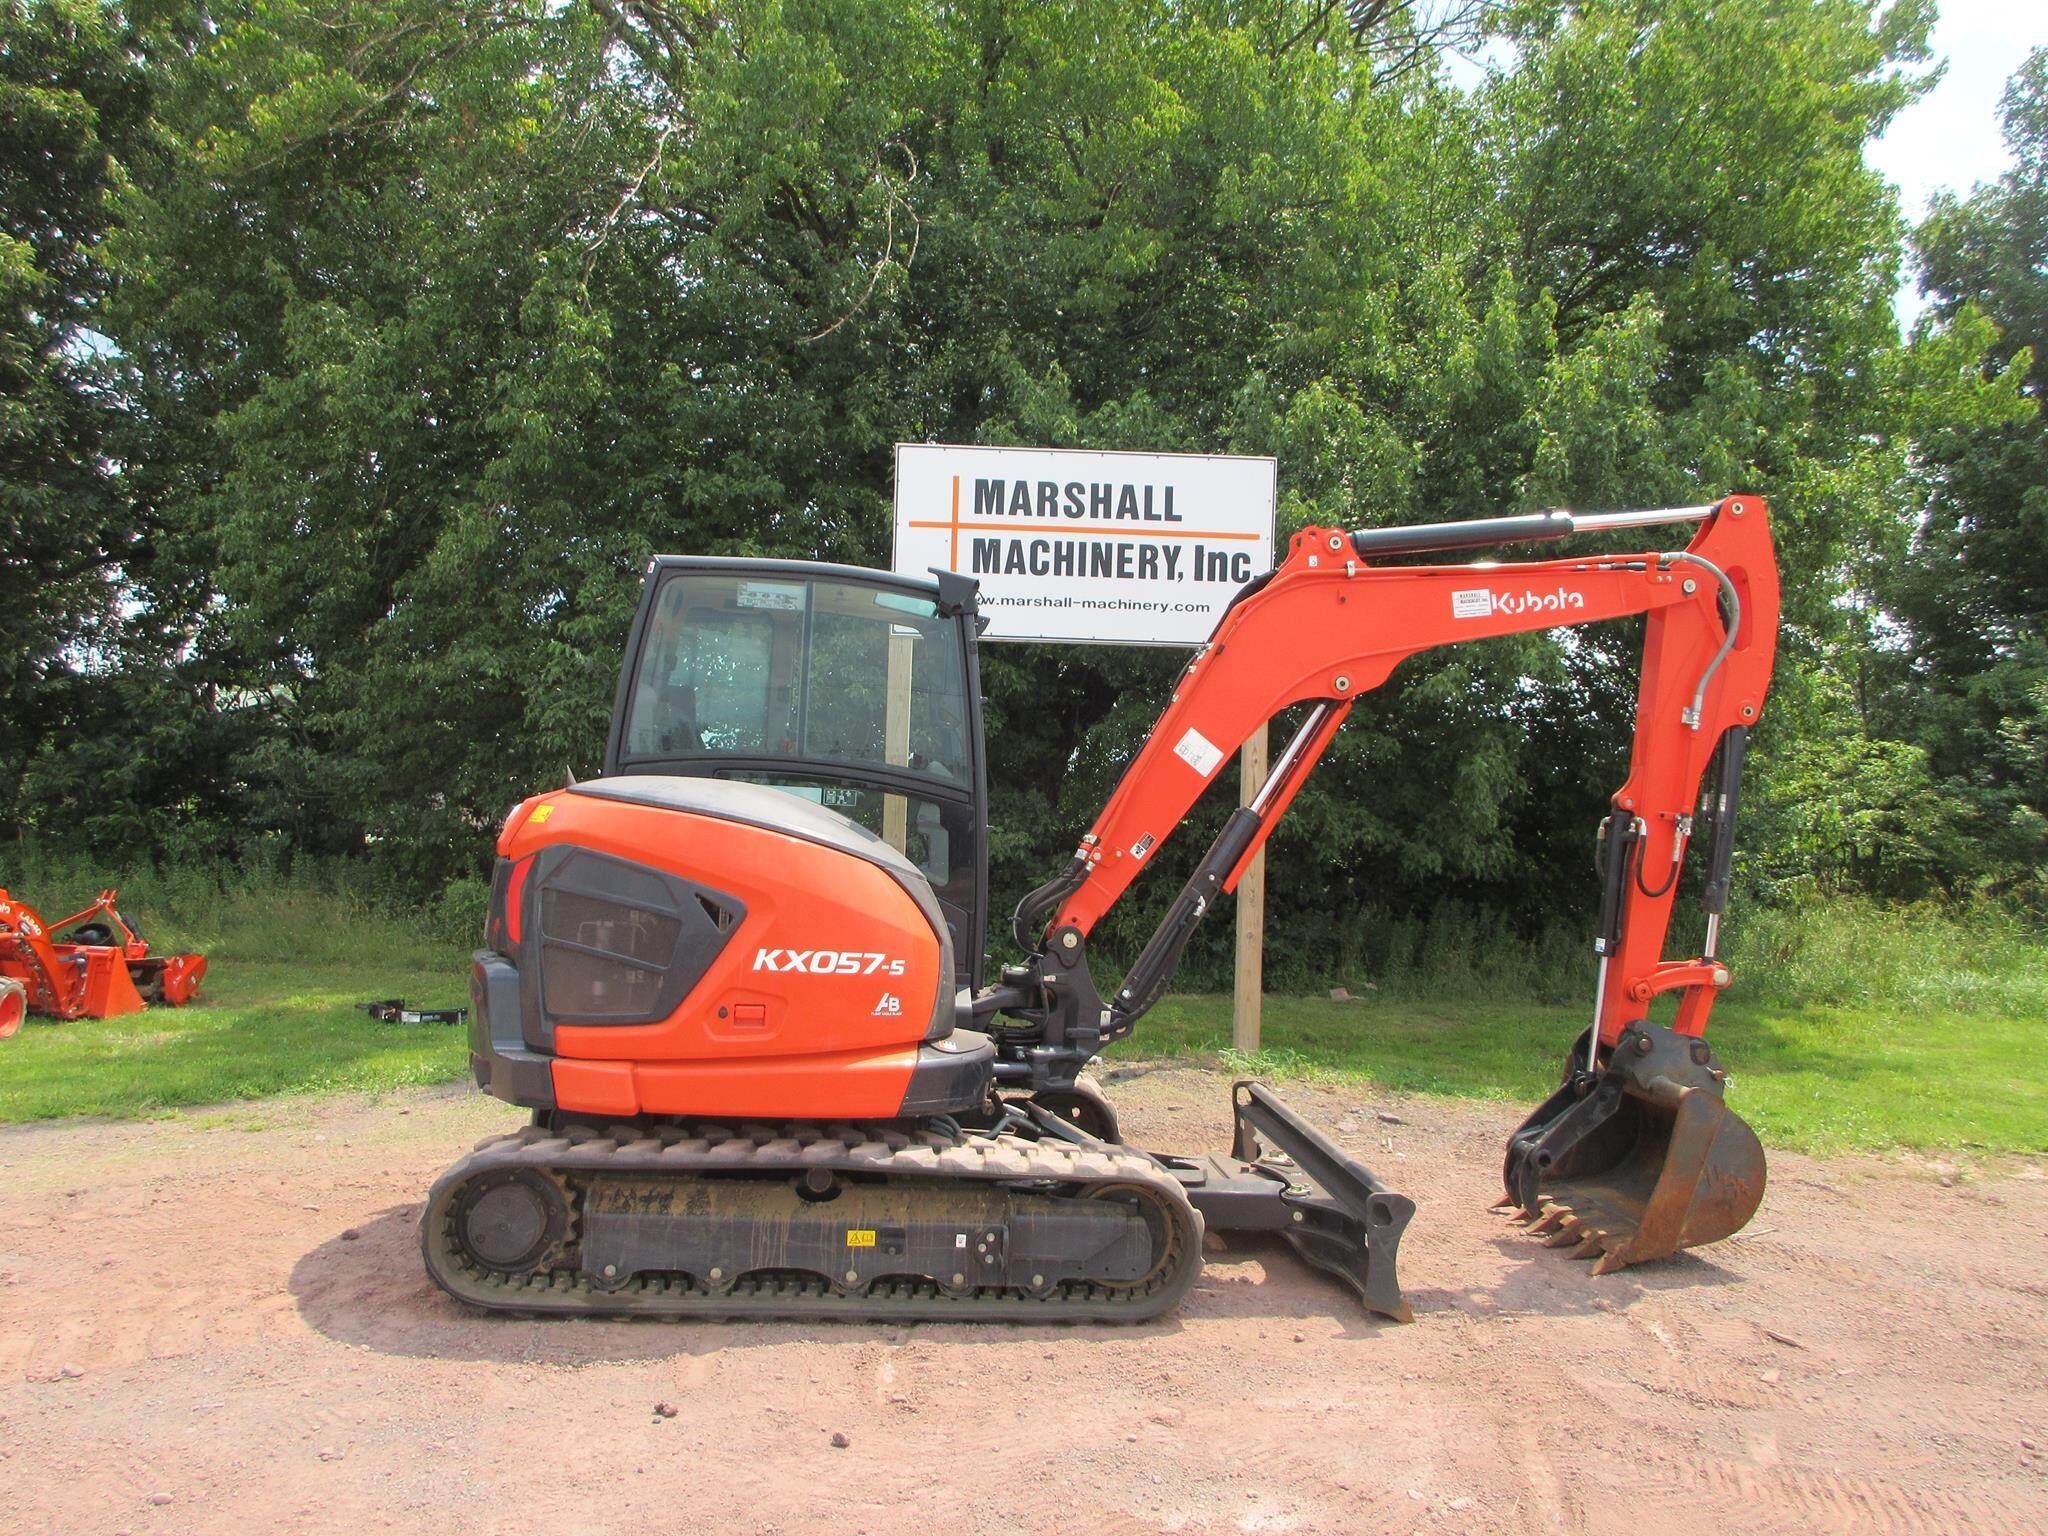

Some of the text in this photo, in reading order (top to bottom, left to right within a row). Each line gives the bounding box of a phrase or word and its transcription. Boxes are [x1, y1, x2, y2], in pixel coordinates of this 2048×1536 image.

[973, 478, 1182, 522] MARSHALL
[972, 538, 1260, 583] MACHINERY, Inc
[977, 595, 1210, 613] w.marshall-machinery.com
[1491, 587, 1584, 614] Kubota
[752, 948, 906, 976] KX057-5
